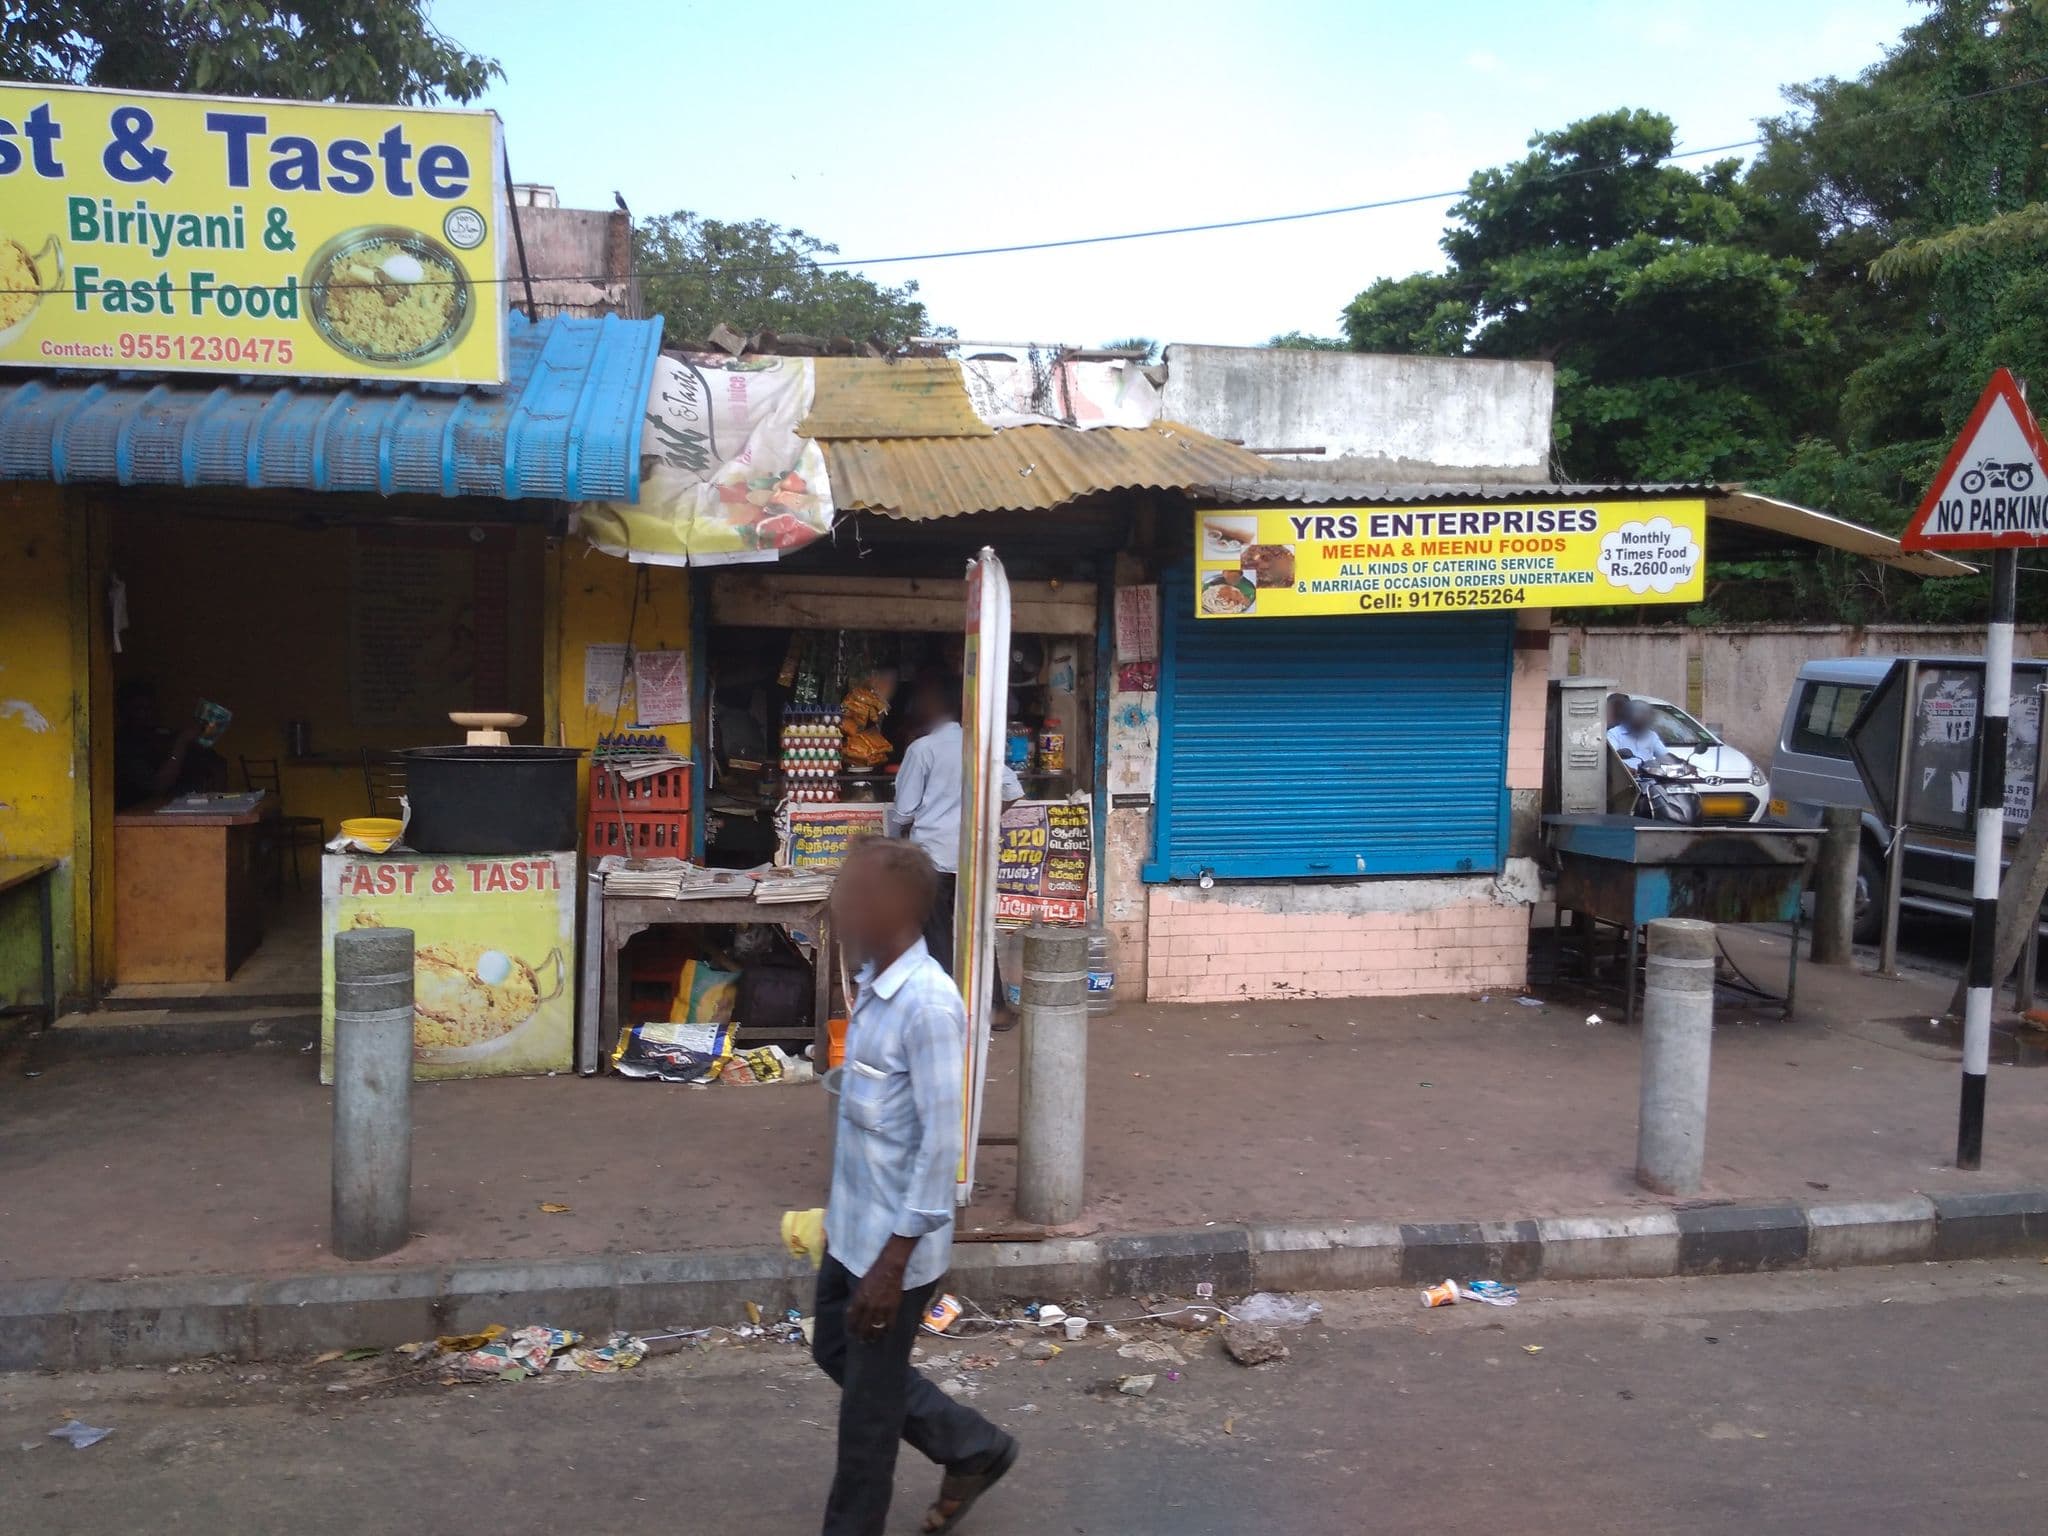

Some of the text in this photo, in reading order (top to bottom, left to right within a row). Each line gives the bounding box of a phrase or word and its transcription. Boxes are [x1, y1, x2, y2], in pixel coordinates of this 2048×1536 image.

[103, 106, 173, 184] &
[206, 112, 470, 199] Taste
[68, 196, 296, 257] Biriyani &
[74, 266, 298, 319] Fast Food
[41, 333, 293, 364] Contact: 9551230475
[1290, 509, 1597, 540] YRS ENTERPRISES
[1937, 499, 1963, 532] NO
[1322, 537, 1566, 559] MEENA & MEENU FOODS
[1621, 531, 1671, 546] Monthly
[1604, 546, 1687, 560] 3 Times Food
[1340, 557, 1554, 577] ALL KINDS OF CATERING SERVICE
[1611, 561, 1691, 576] Rs.2600 only
[1298, 571, 1594, 593] & MARRIAGE OCCASION ORDERS UNDERTAKEN
[1360, 588, 1525, 610] Cell: 9176525264
[1006, 828, 1046, 848] 120
[432, 864, 455, 893] &
